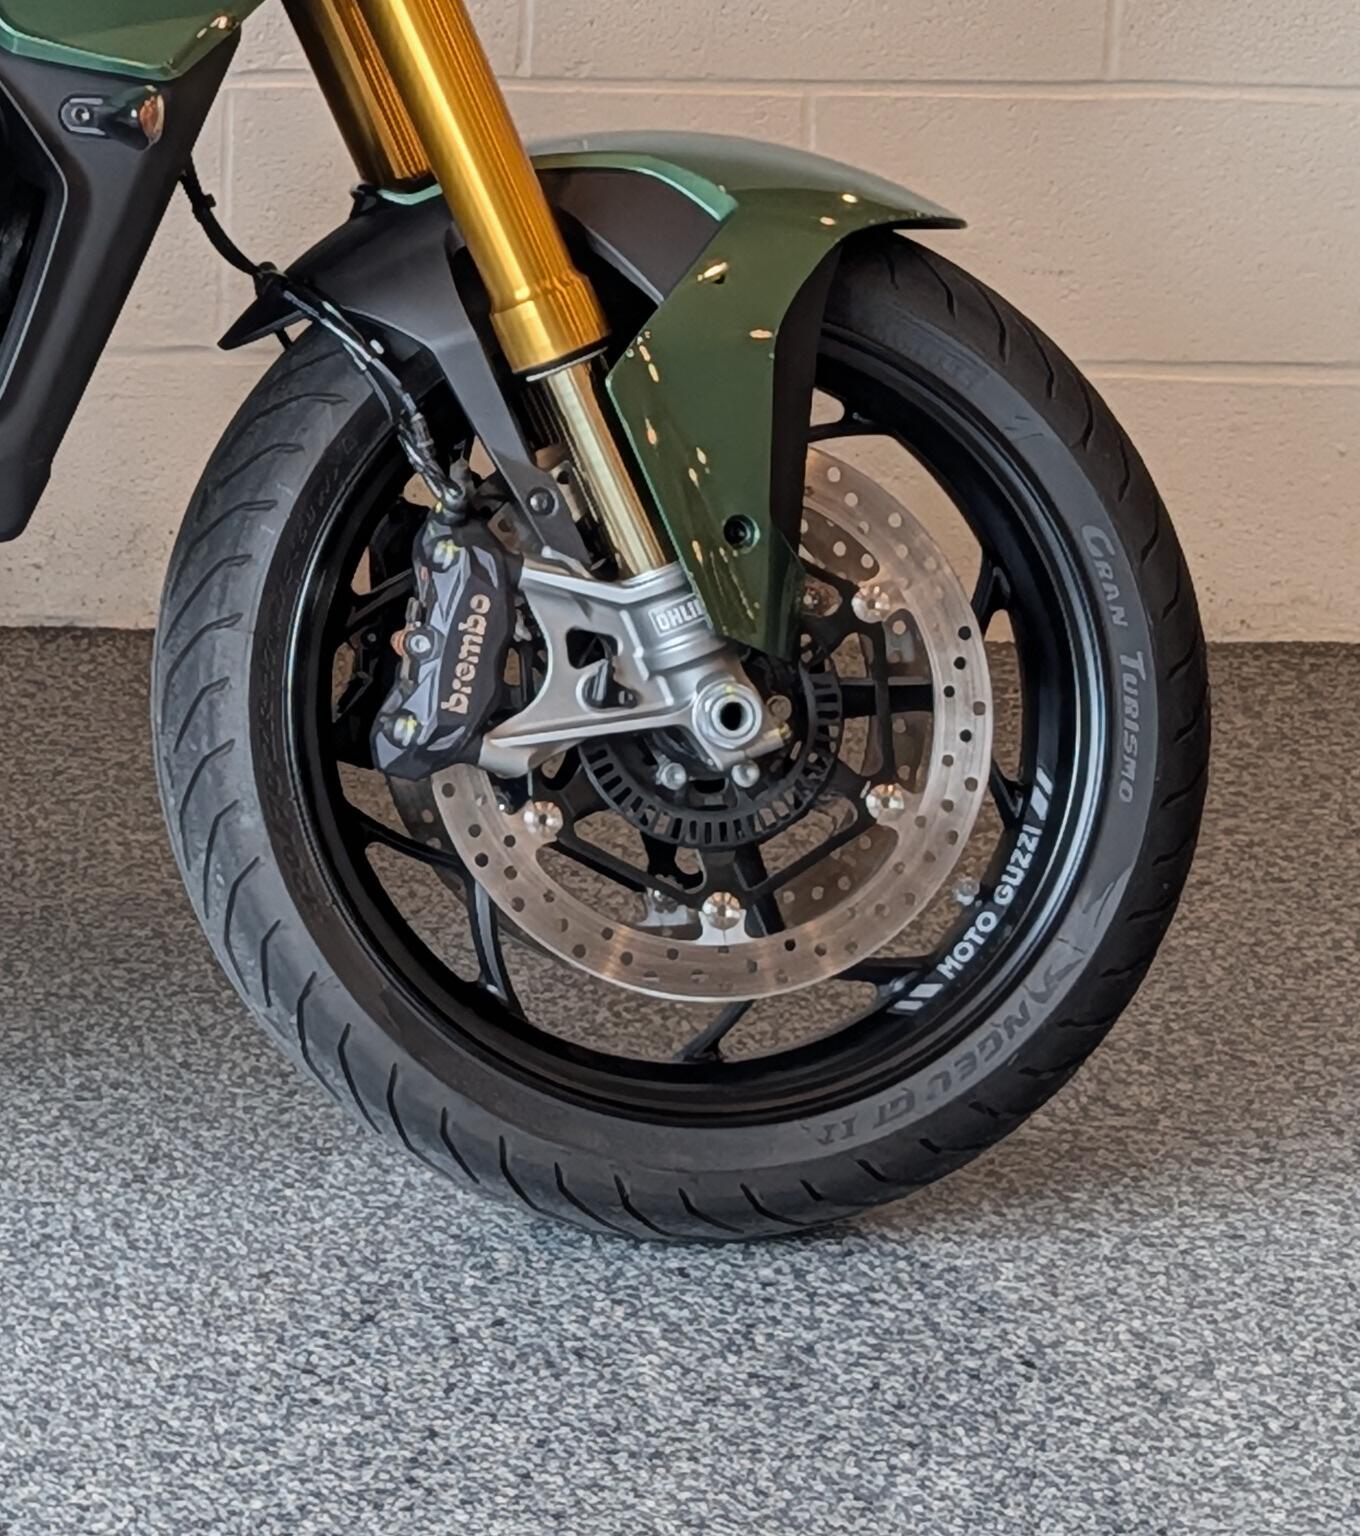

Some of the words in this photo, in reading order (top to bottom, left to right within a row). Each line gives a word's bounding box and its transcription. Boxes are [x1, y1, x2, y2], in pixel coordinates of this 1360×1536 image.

[440, 593, 491, 715] brembo
[1081, 524, 1129, 627] GRAN
[1118, 650, 1147, 802] TURISMO
[936, 910, 998, 981] MOTO
[993, 823, 1043, 906] GUZZI
